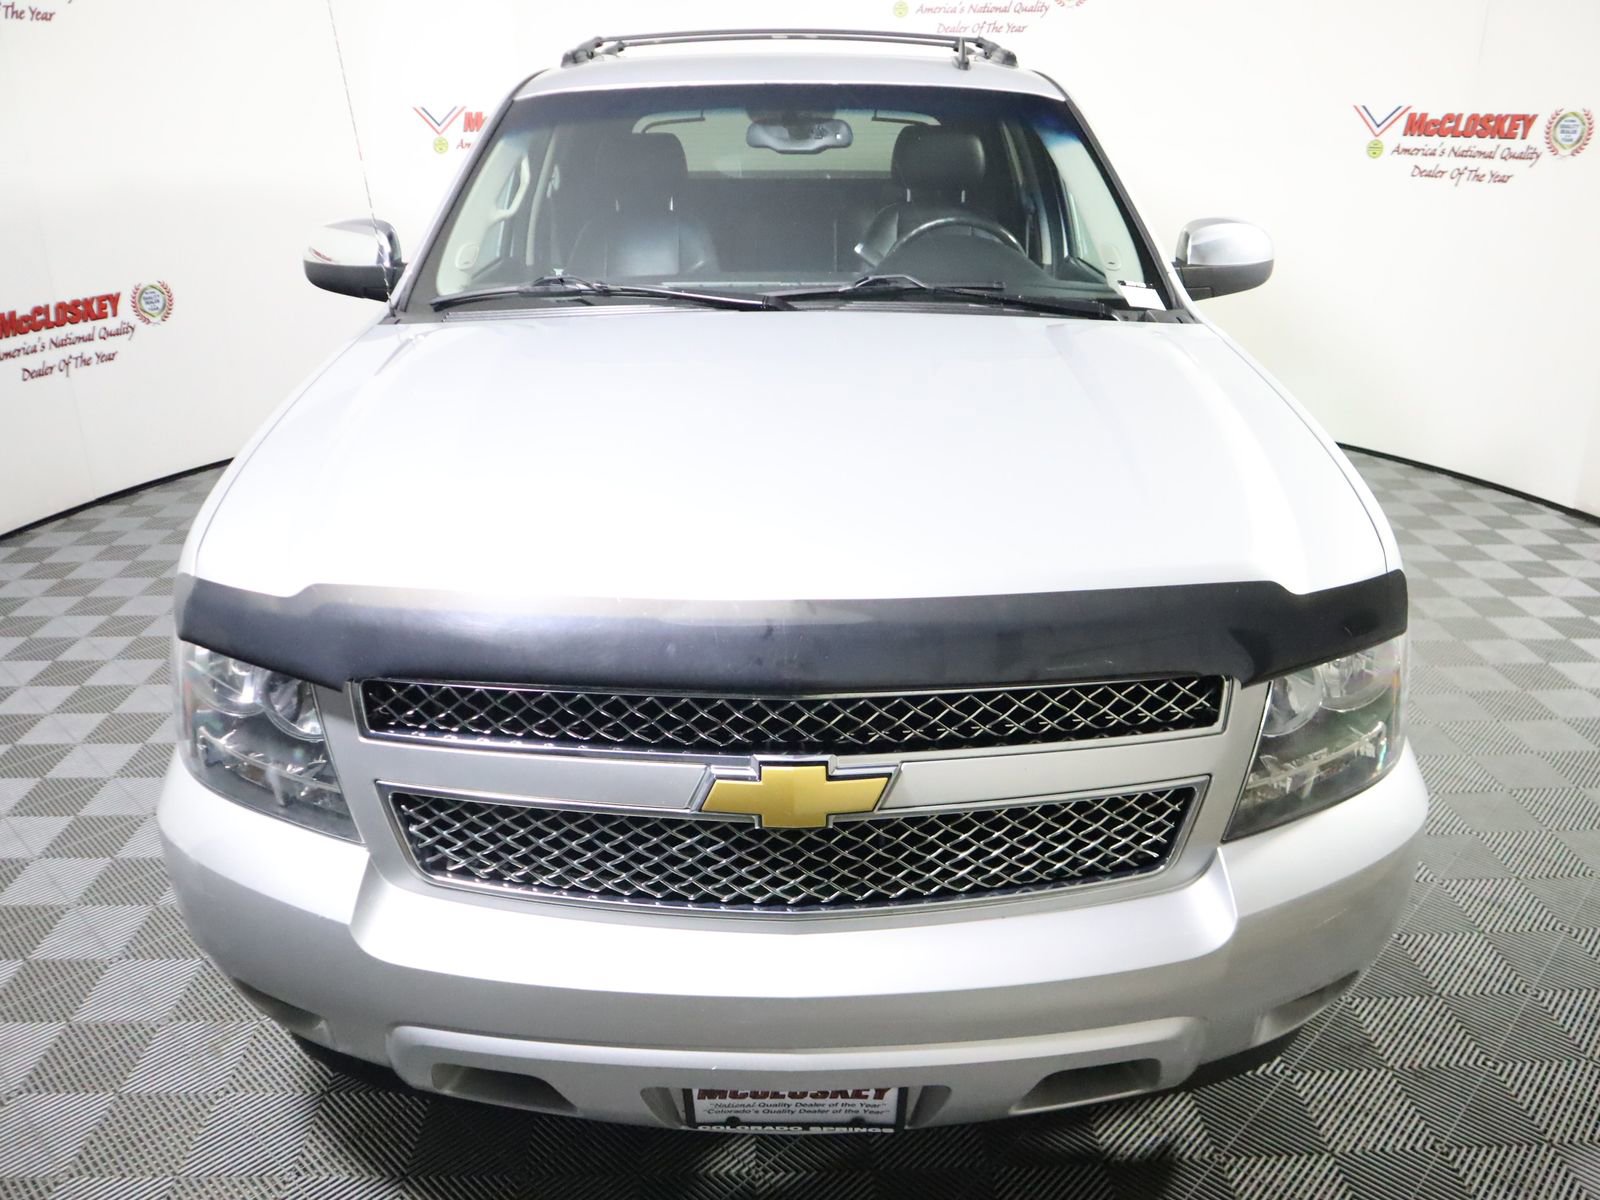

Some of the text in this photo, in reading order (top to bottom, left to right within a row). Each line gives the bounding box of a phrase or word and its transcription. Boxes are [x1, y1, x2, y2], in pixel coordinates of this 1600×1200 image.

[2, 1, 56, 21] The Year
[914, 0, 965, 15] America's
[967, 0, 1012, 14] National
[1013, 0, 1049, 18] Quality
[936, 20, 1028, 37] Dealer Of The Year
[1402, 112, 1539, 140] McCLOSKEY
[1391, 142, 1446, 157] America's
[1447, 144, 1500, 160] National
[1500, 145, 1542, 168] Quality
[1411, 164, 1514, 187] Dealer Of The Year
[0, 320, 136, 361] merica's National Quality
[21, 350, 119, 382] Dealer Of The Year
[762, 1108, 797, 1116] Quality
[808, 1126, 895, 1134] SPRINGS
